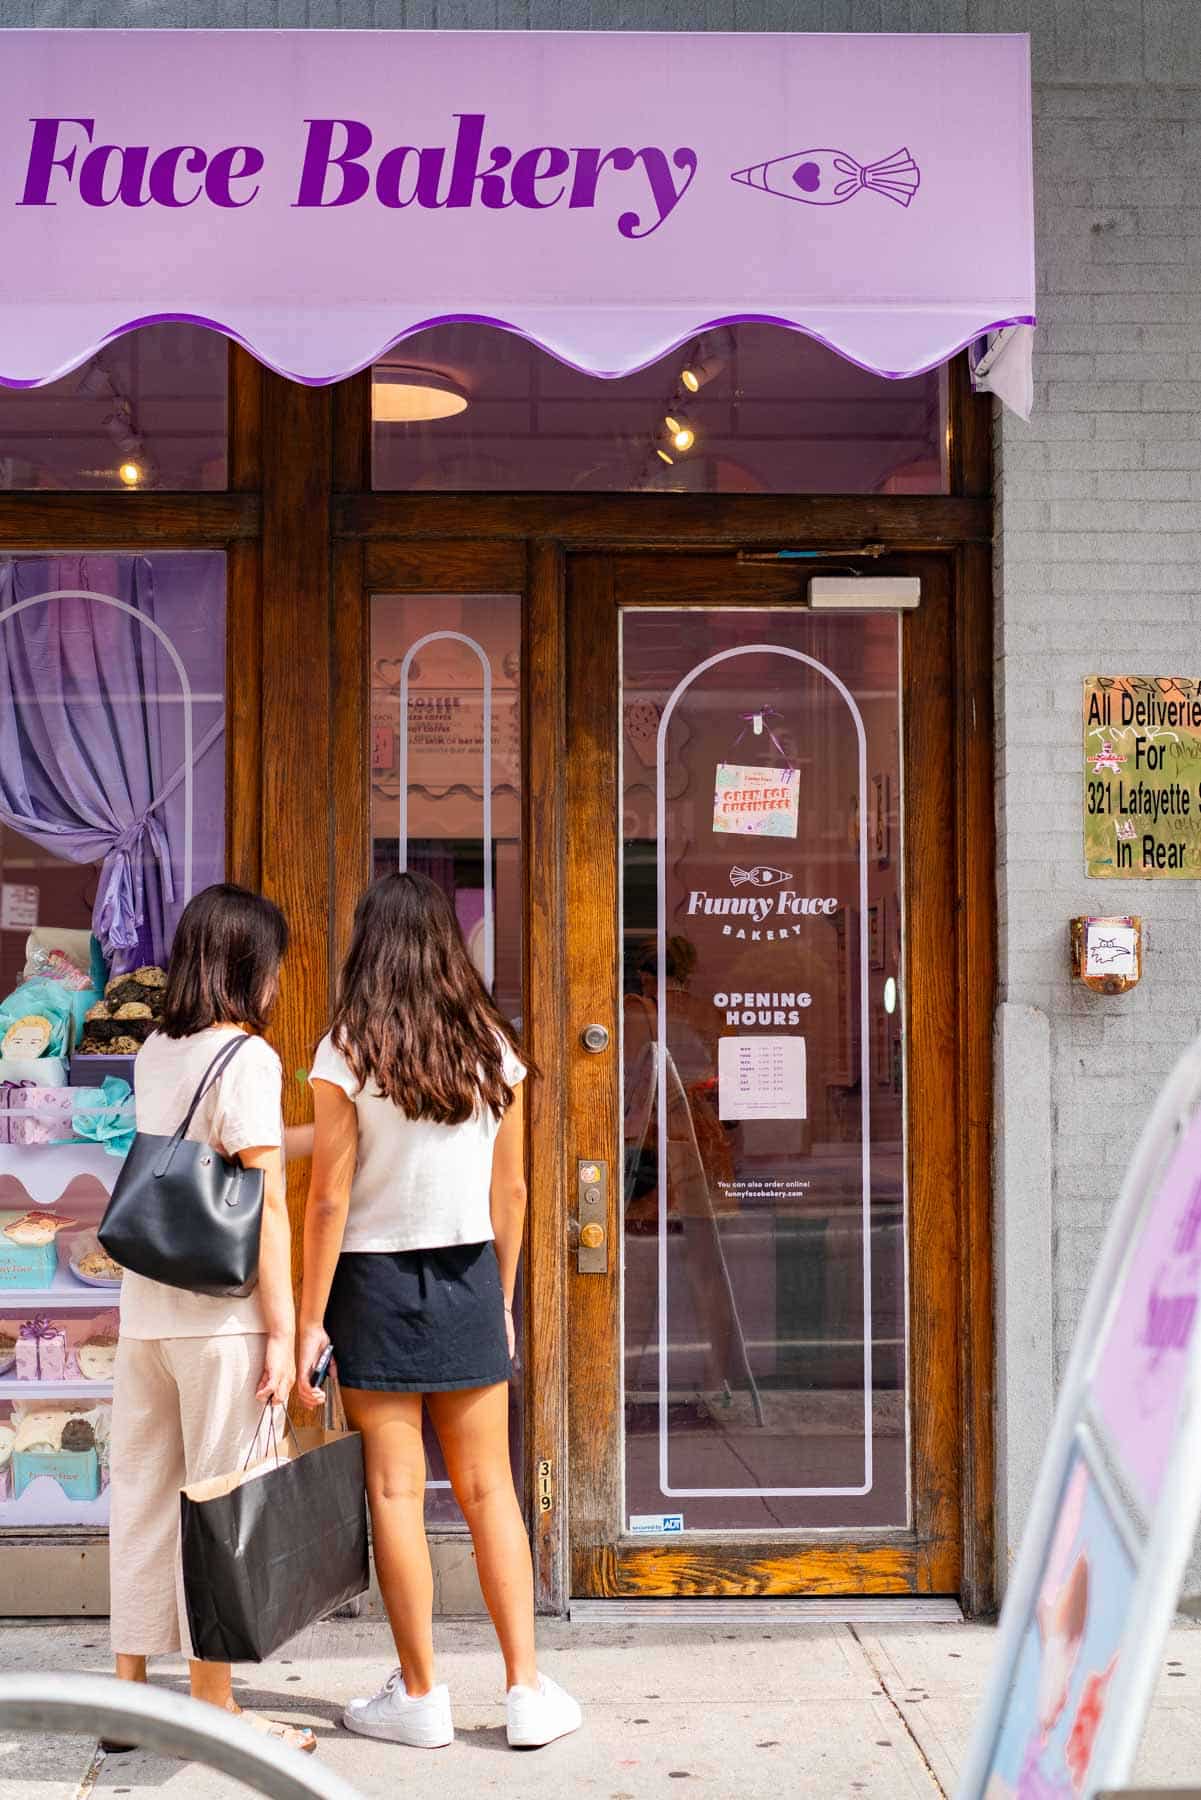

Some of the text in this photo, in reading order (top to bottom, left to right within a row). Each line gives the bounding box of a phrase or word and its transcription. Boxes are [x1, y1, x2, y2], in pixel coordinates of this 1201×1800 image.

[16, 114, 698, 239] Face Bakery
[1088, 692, 1201, 727] All Deliverie
[1135, 737, 1166, 770] For
[1087, 782, 1112, 815] 321
[1119, 780, 1190, 824] Lafayette
[1117, 835, 1186, 870] In Rear
[687, 891, 838, 921] Funny Face
[722, 924, 802, 941] BAKERY
[713, 992, 813, 1008] OPENING
[726, 1011, 800, 1026] HOURS
[717, 1180, 731, 1188] You
[747, 1180, 763, 1188] also
[764, 1180, 784, 1188] order
[541, 1462, 551, 1510] 319
